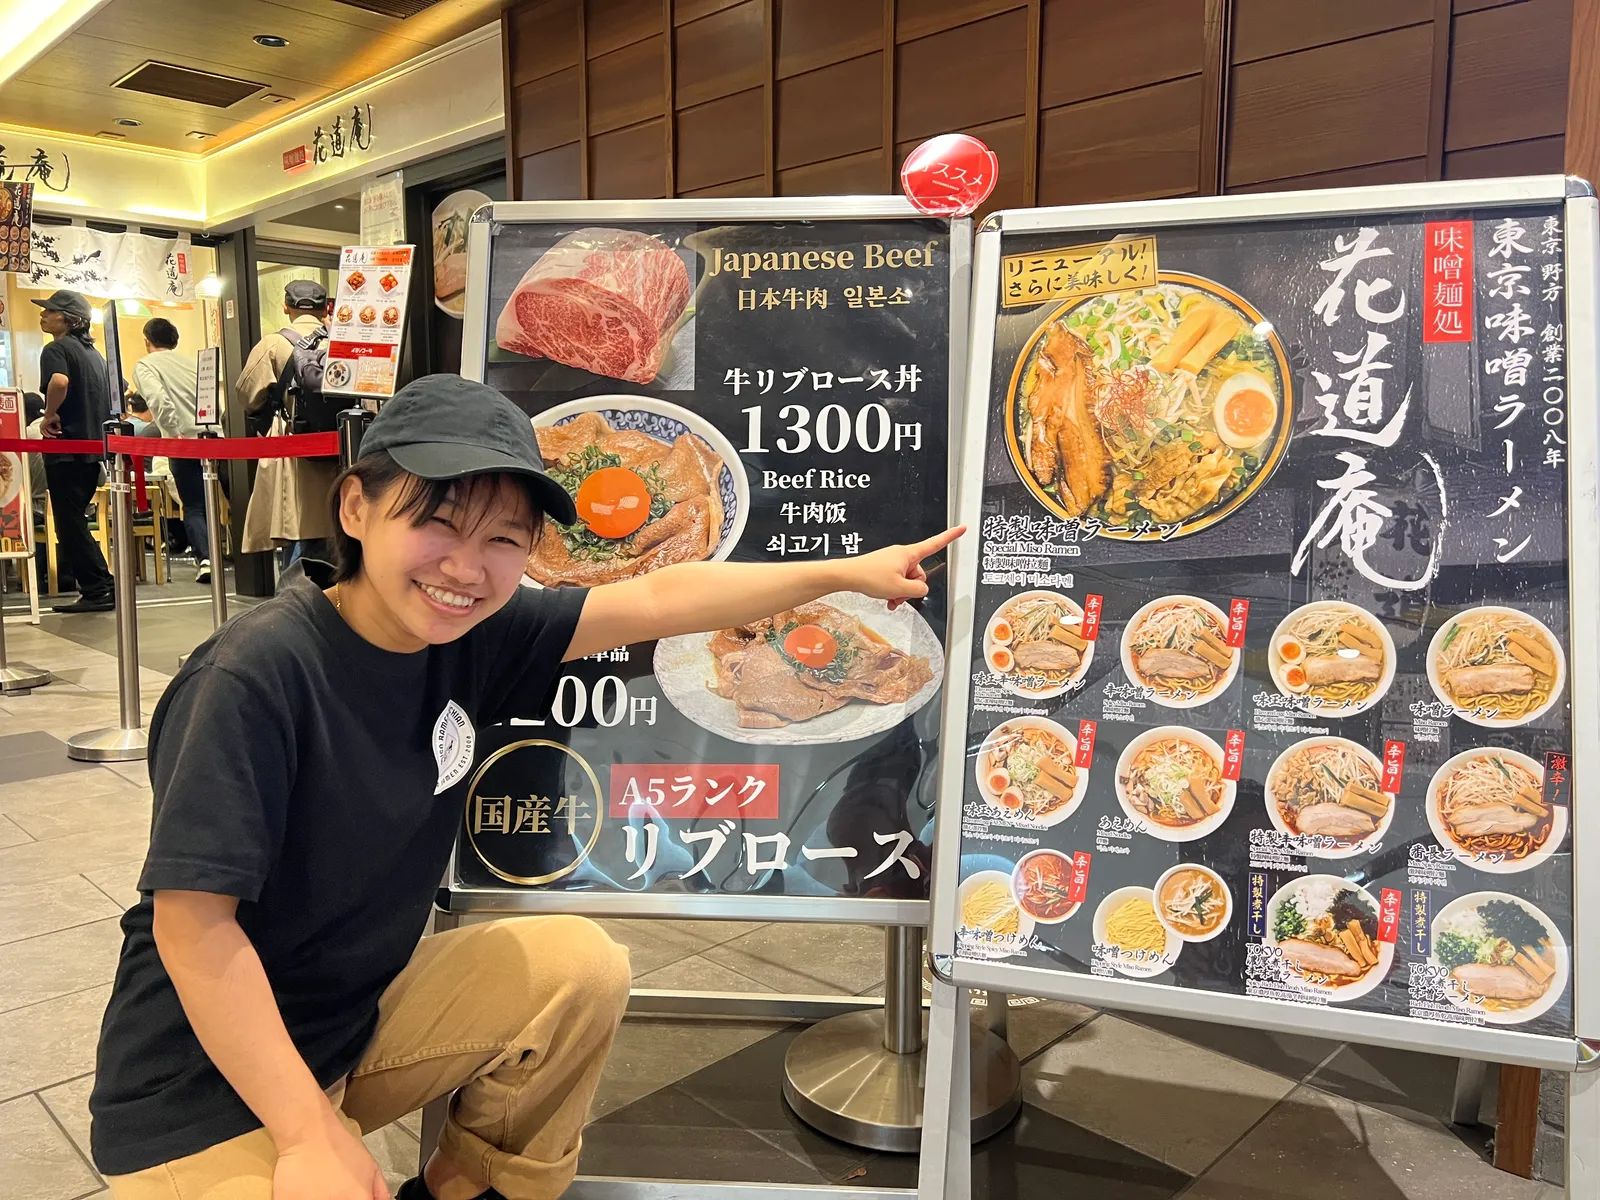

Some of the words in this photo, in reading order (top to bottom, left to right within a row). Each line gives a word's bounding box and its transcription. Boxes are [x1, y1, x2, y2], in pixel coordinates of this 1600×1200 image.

[1541, 215, 1563, 255] 東京
[708, 244, 855, 279] Japanese
[863, 240, 936, 270] Beef
[1541, 263, 1564, 302] 野方
[736, 288, 828, 311] 日本牛肉
[842, 285, 911, 309] 일본소
[722, 365, 923, 396] 牛リブロース丼
[1484, 217, 1535, 564] 東京味噌ラーメン
[1290, 226, 1447, 591] 花道庵
[738, 402, 923, 455] 1300円
[762, 469, 817, 490] Beef
[819, 470, 871, 490] Rice
[779, 501, 847, 525] 牛肉饭
[982, 515, 1183, 543] 特製味噌ラーメン
[765, 533, 830, 556] 쇠고기
[840, 532, 864, 555] 밥
[984, 541, 1018, 555] Special
[1019, 542, 1043, 553] Miso
[1044, 543, 1080, 555] Ramen
[1410, 701, 1498, 719] 味噌ラーメン
[618, 775, 767, 808] A5ランク
[473, 795, 592, 837] 国産牛
[1098, 814, 1147, 833] あえめん
[621, 818, 922, 882] リブロース
[1249, 828, 1383, 854] 特製辛味噌ラーメン
[1409, 843, 1506, 865] 番長ラーメン
[957, 925, 1041, 949] 辛味噌つけめん
[1092, 943, 1174, 966] 味噌つけめん
